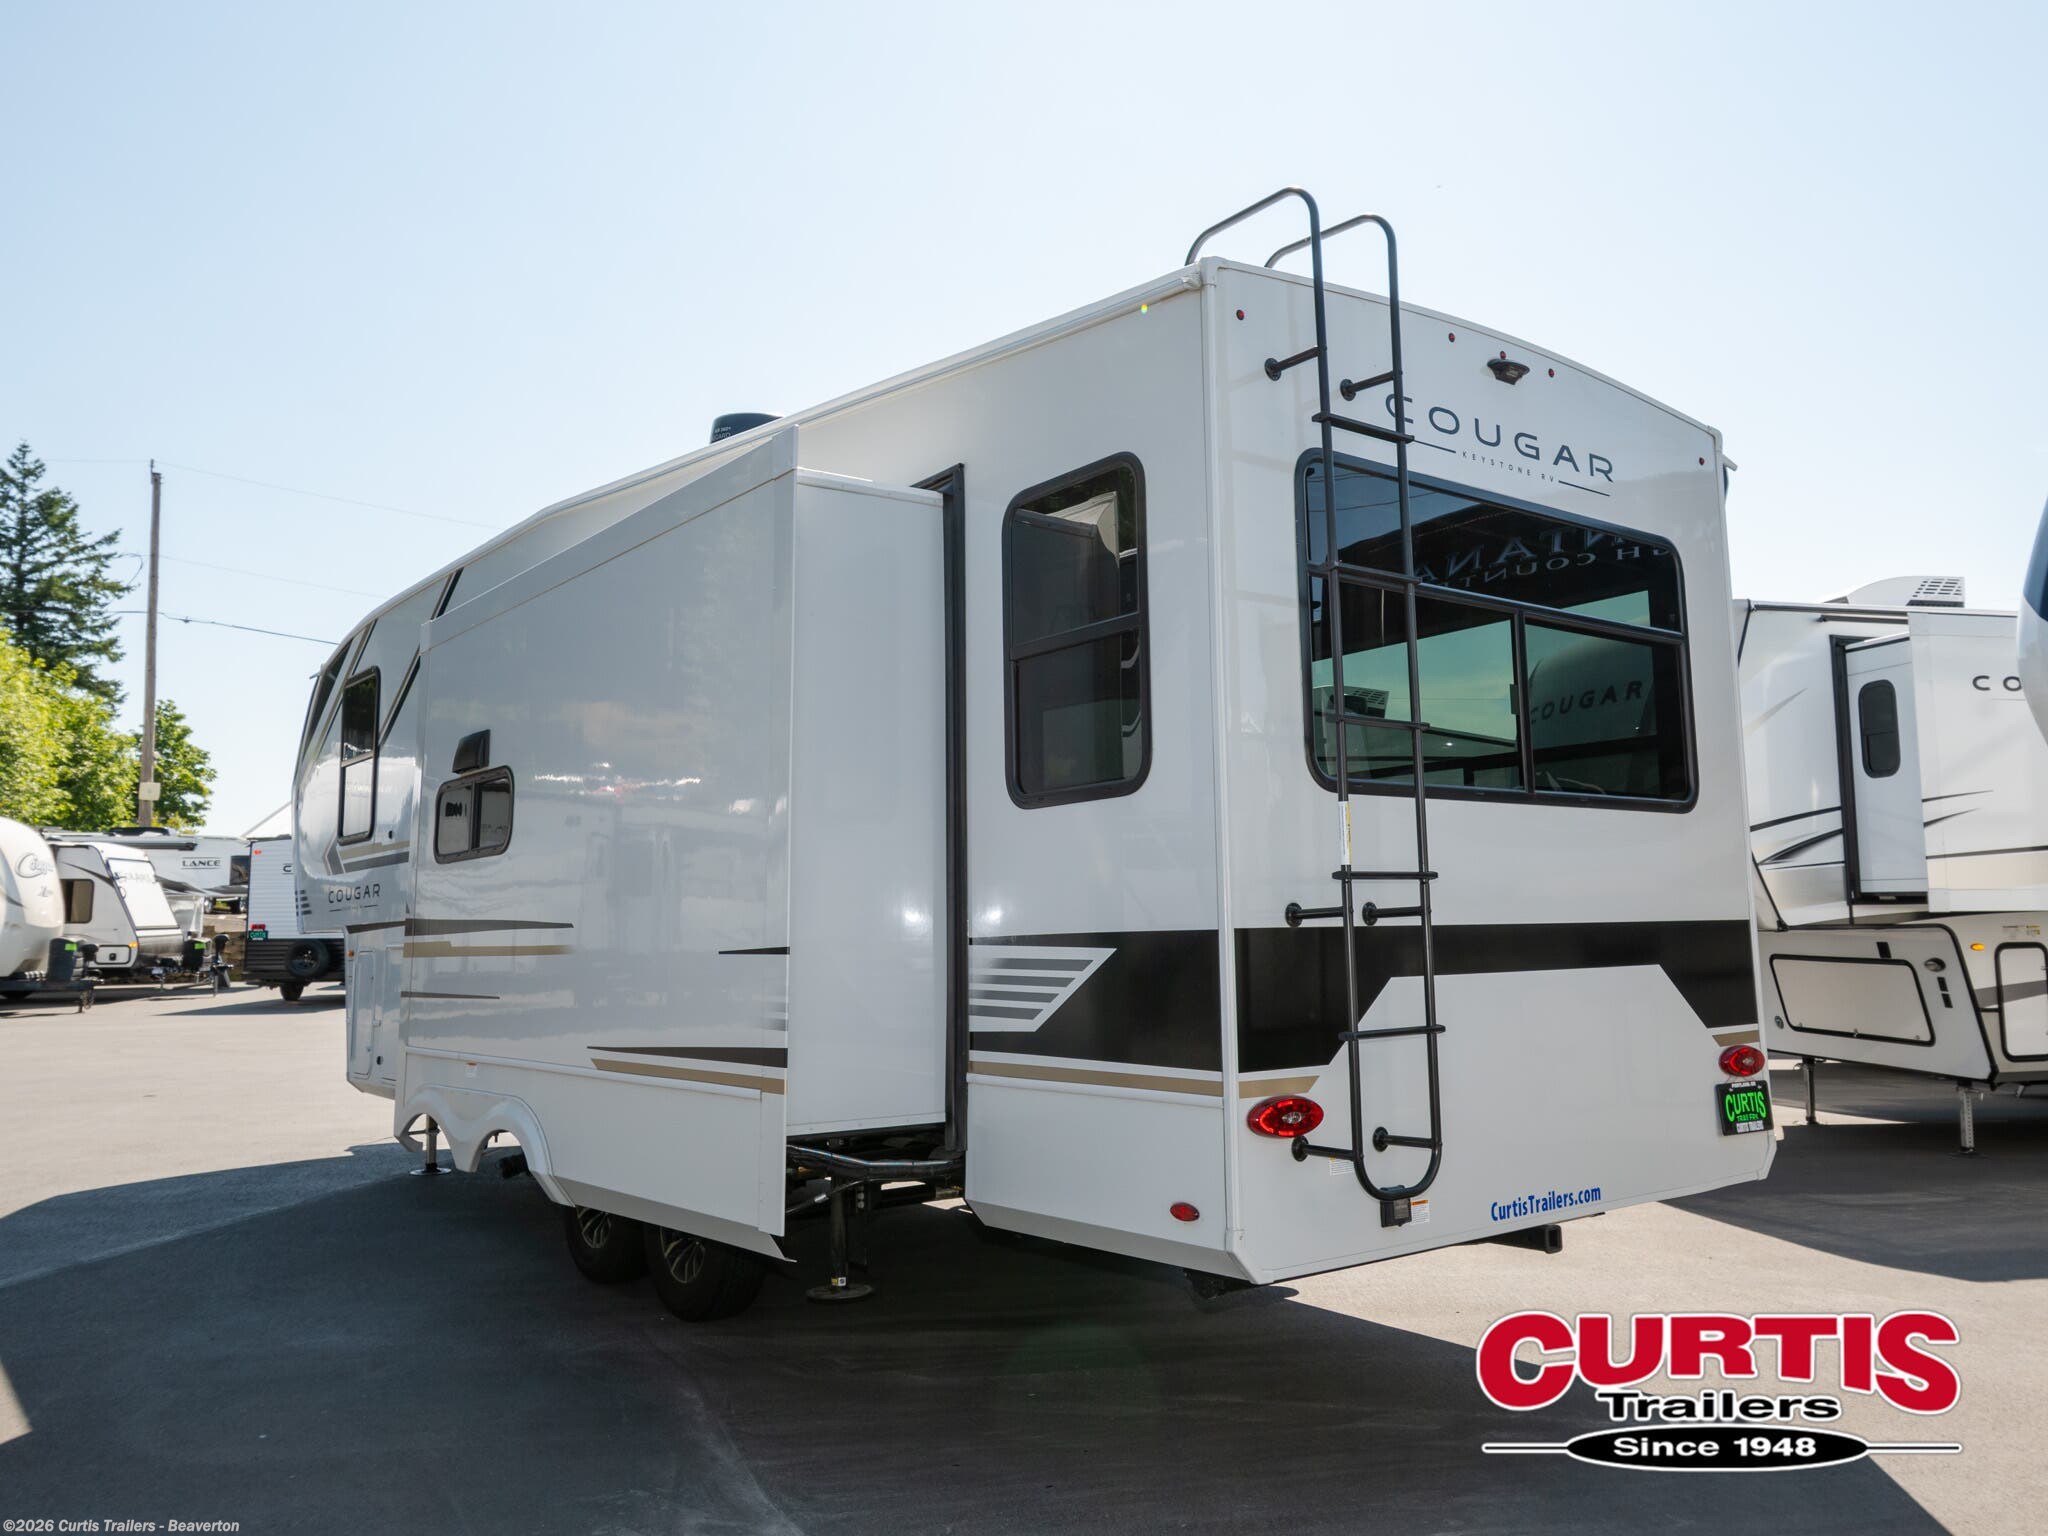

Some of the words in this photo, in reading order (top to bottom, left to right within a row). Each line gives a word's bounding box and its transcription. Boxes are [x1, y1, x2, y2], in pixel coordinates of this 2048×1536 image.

[1385, 393, 1613, 483] COUGAR
[1462, 450, 1531, 477] KEYSTONE
[1541, 473, 1554, 483] RV
[182, 859, 222, 867] LANCE
[328, 883, 381, 904] COUGAR
[1725, 1091, 1767, 1122] CURTIS
[1490, 1186, 1602, 1222] CurtisTrailers.com
